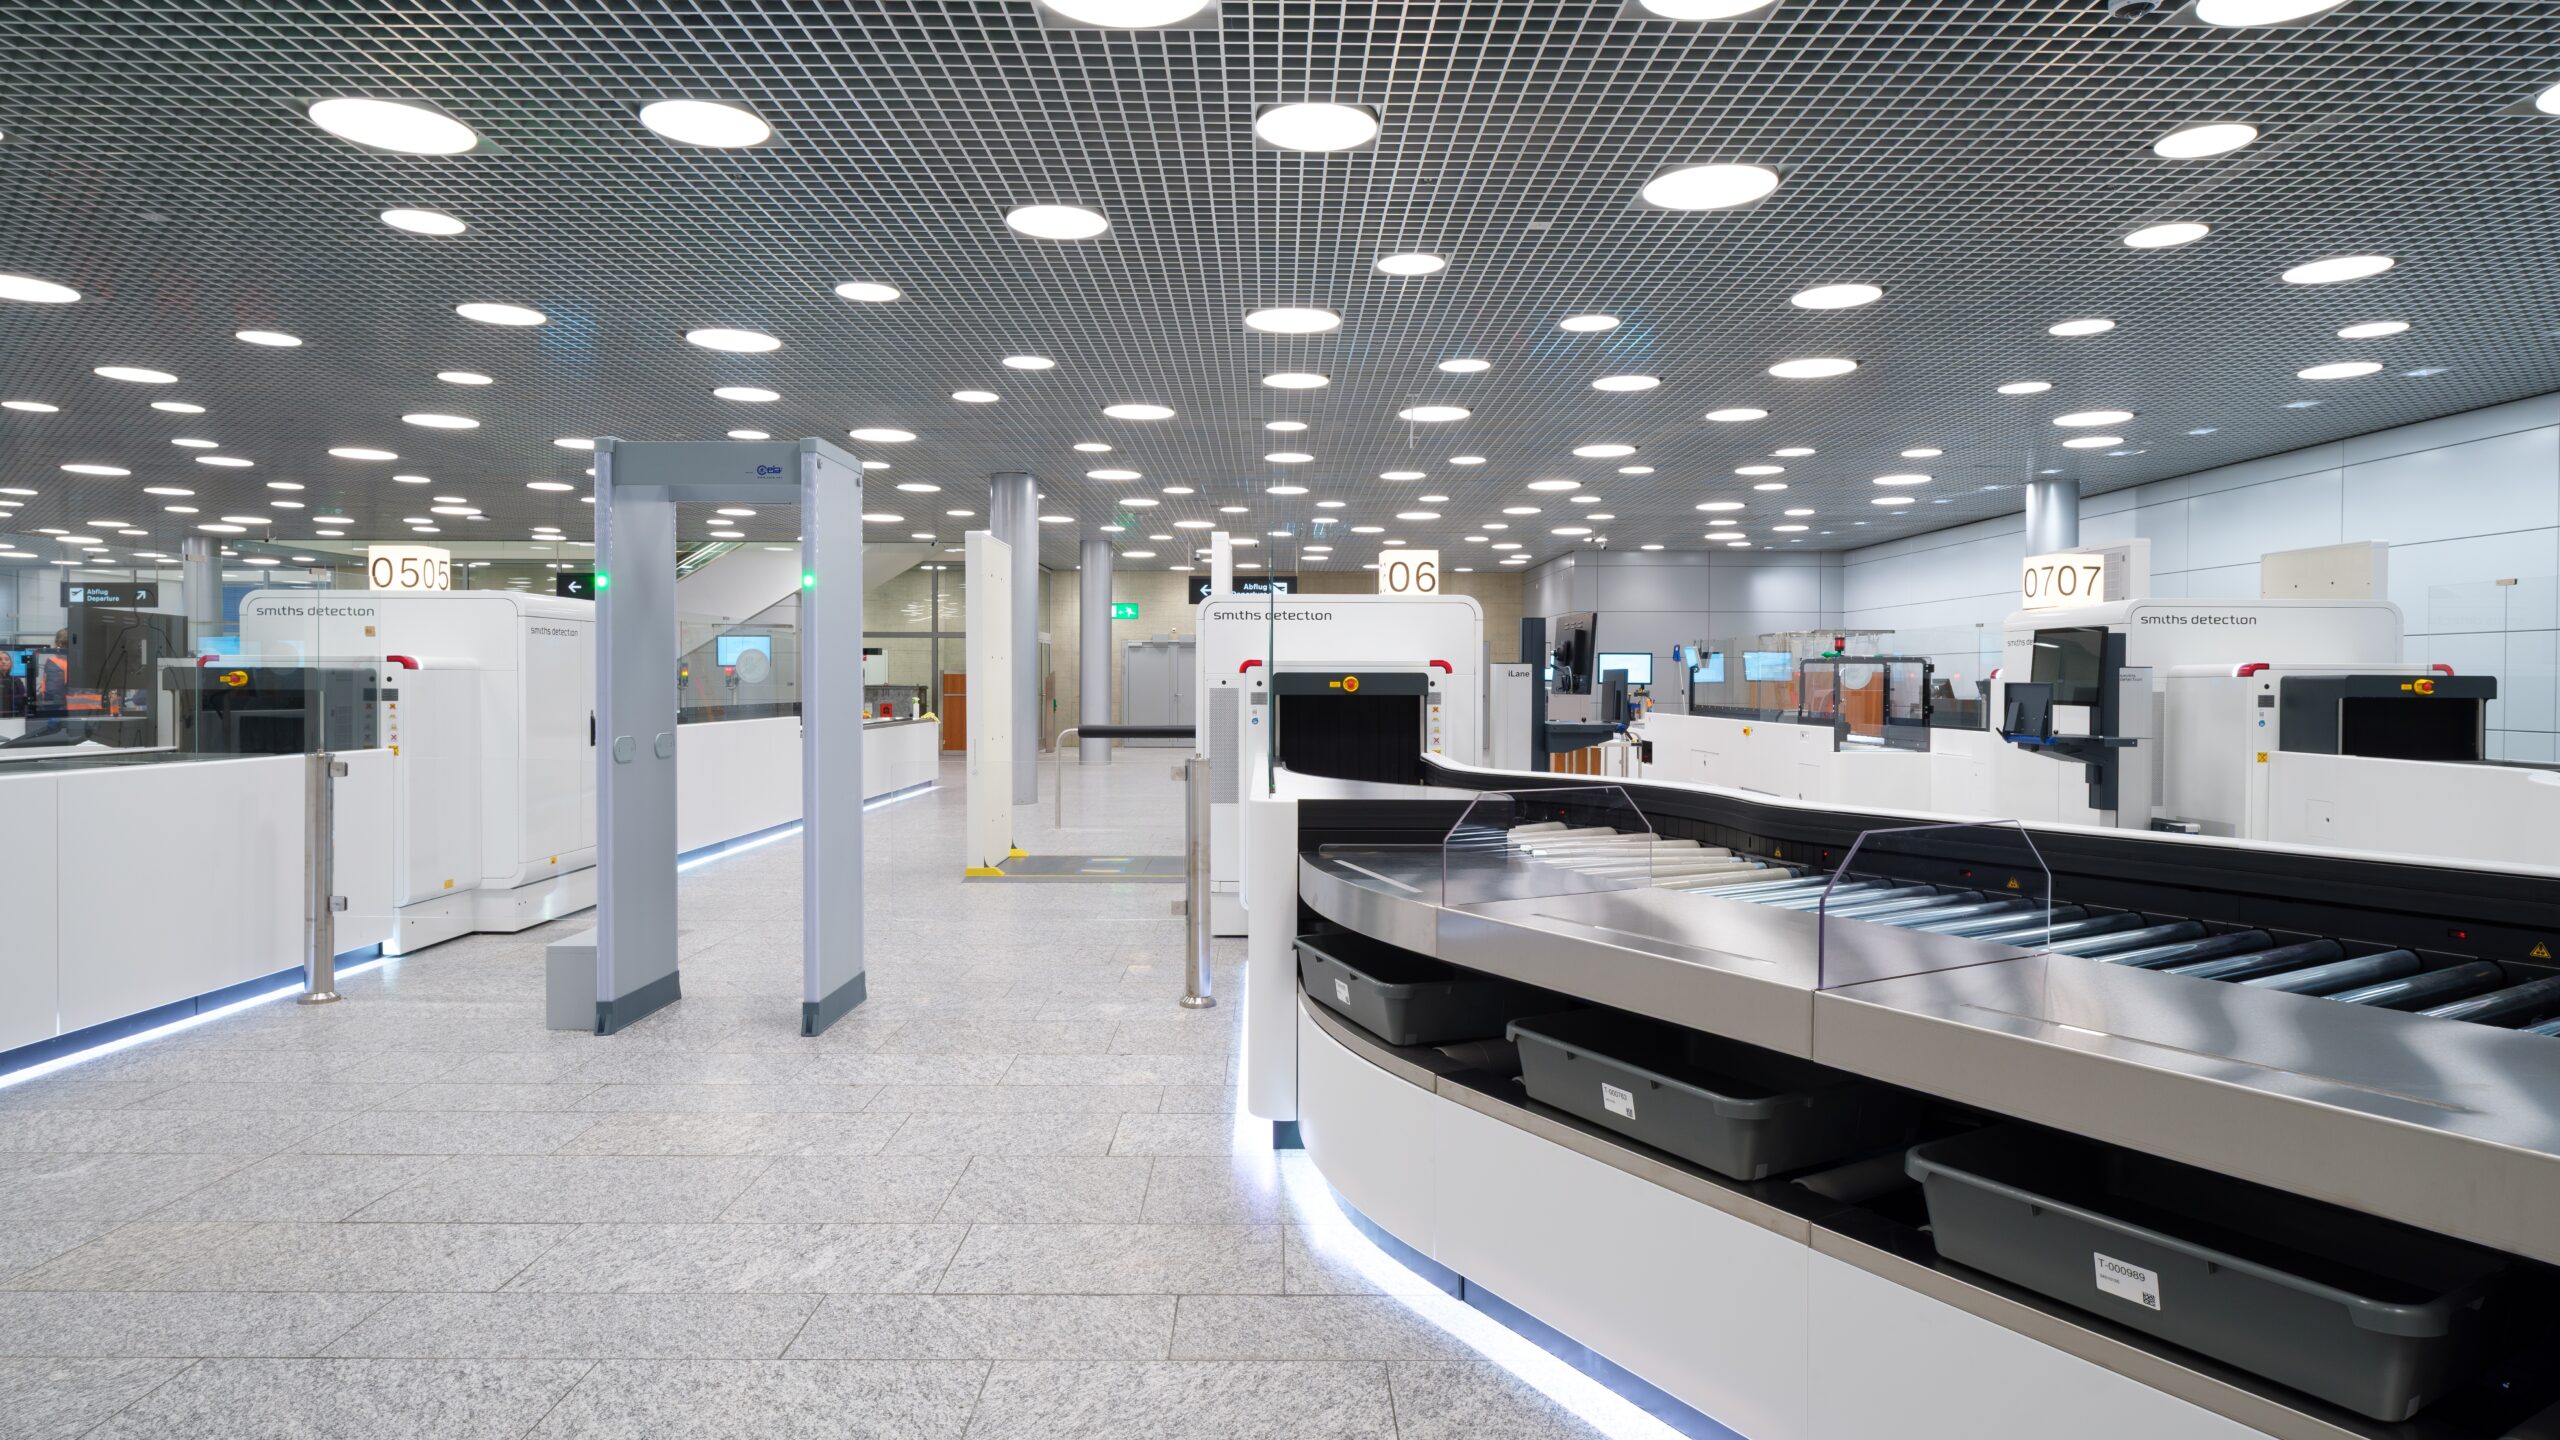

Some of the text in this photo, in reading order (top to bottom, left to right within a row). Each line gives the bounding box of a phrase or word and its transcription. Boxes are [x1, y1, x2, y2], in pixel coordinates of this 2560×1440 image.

[372, 557, 419, 588] 05
[423, 558, 448, 590] 05
[1389, 561, 1436, 592] 06
[2024, 567, 2054, 598] 07
[2057, 565, 2101, 596] 07
[1243, 583, 1268, 591] Abflug
[256, 606, 375, 616] smiths detection
[1213, 610, 1261, 621] smiths
[2140, 614, 2257, 625] smiths detection
[2097, 1257, 2146, 1282] T-000989
